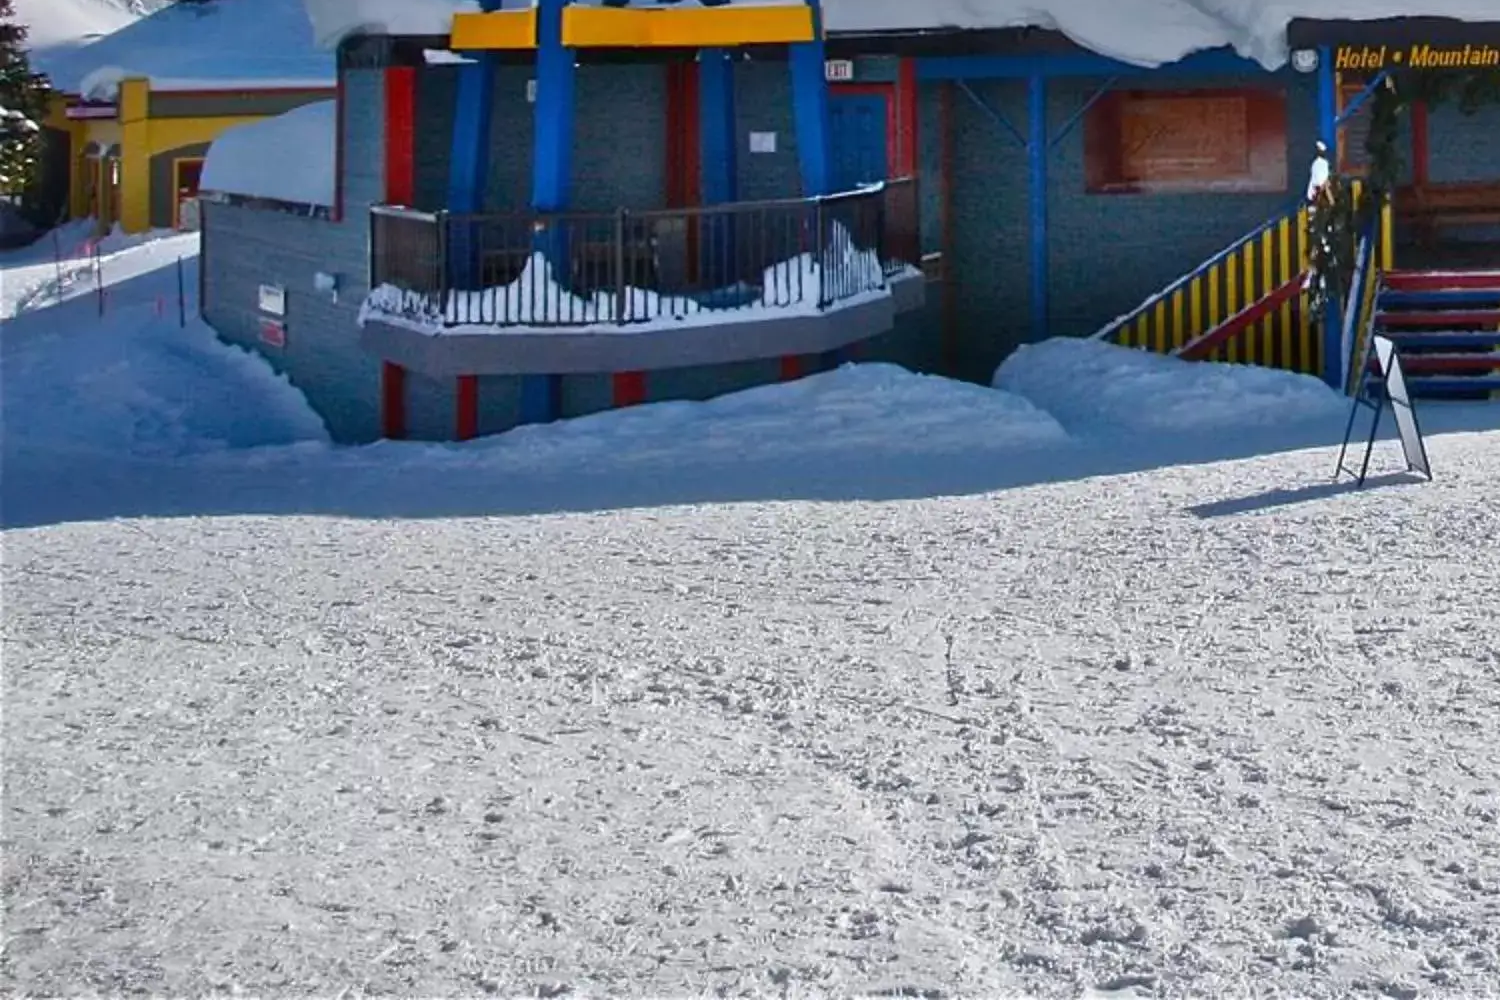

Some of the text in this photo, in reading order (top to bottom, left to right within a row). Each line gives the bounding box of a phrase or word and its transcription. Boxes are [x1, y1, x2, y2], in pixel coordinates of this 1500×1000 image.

[1336, 45, 1387, 68] Hotel
[1409, 44, 1500, 68] Mountain
[827, 63, 849, 77] EXIT
